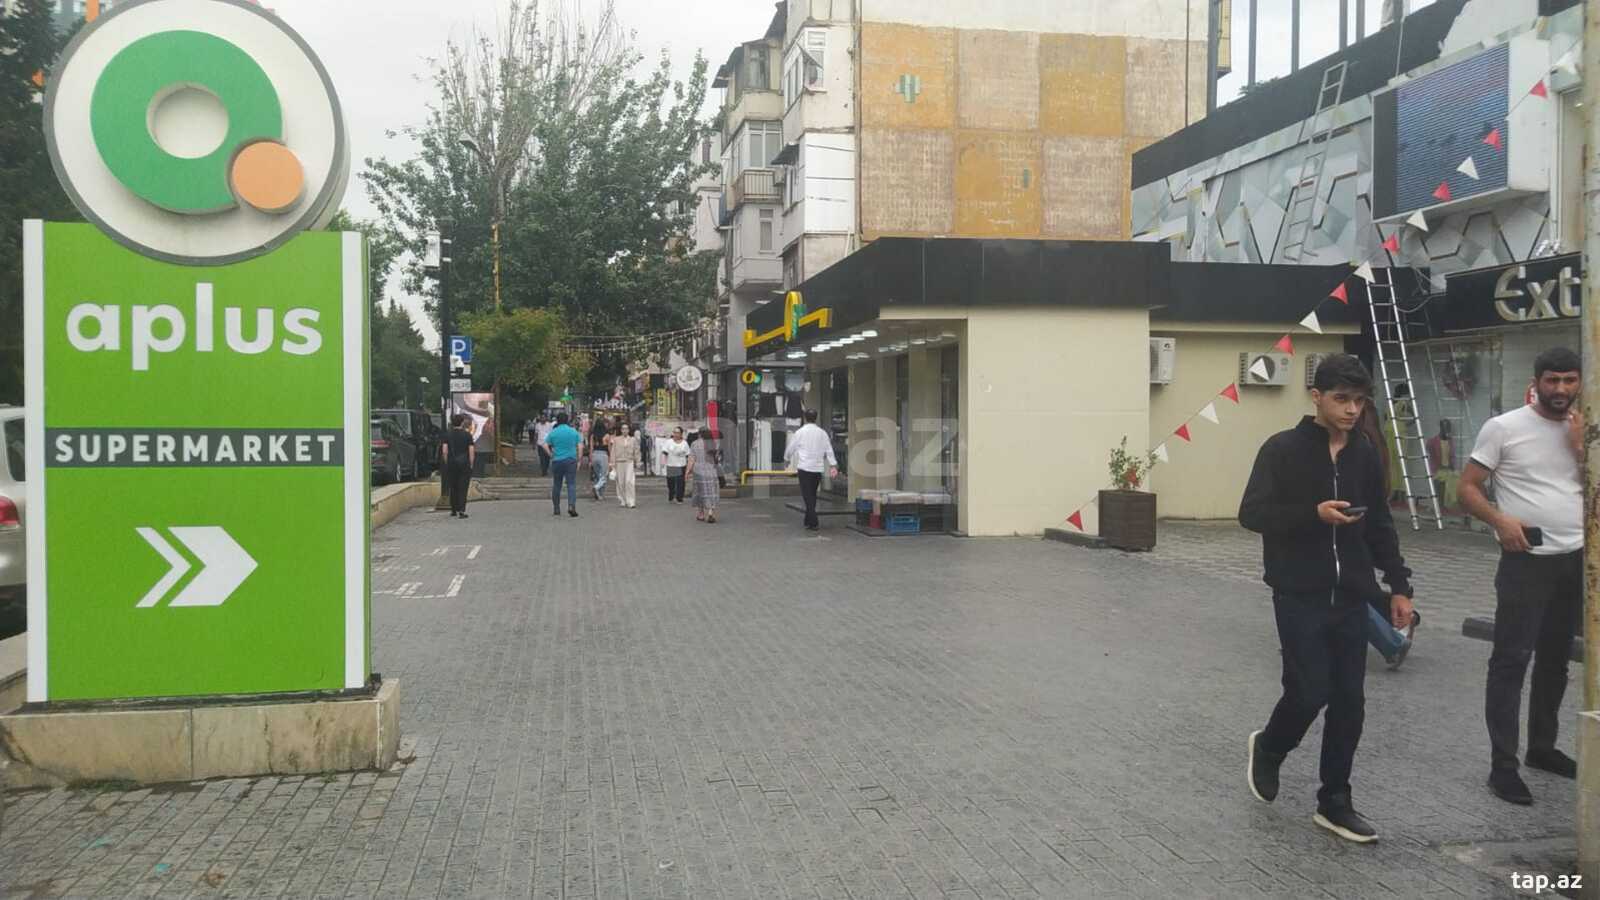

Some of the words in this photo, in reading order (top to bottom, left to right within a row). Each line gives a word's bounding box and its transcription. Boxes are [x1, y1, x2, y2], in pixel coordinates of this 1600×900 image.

[65, 282, 323, 371] aplus
[452, 340, 466, 356] P
[55, 434, 336, 463] SUPERMARKET
